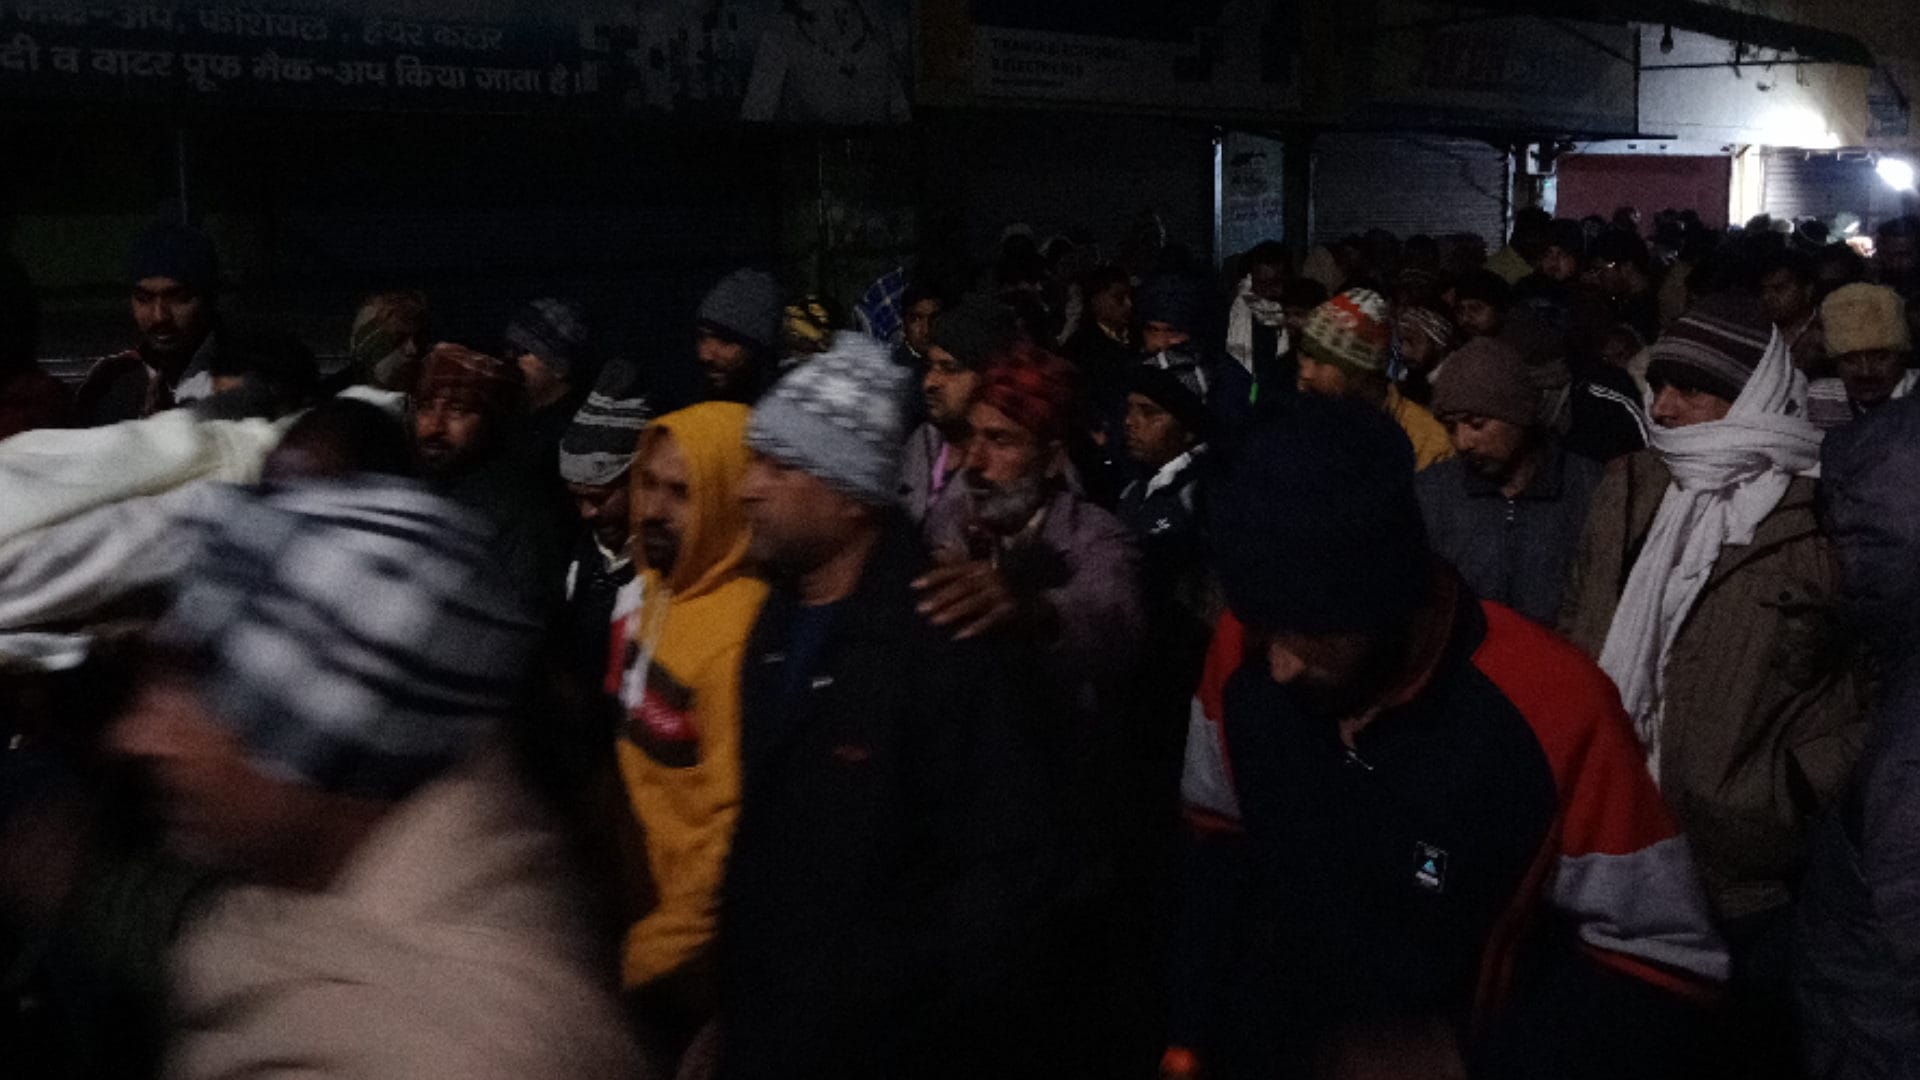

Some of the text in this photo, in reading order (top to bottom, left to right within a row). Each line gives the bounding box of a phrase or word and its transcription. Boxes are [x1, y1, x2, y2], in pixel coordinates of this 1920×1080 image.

[90, 47, 174, 76] वाटर
[394, 54, 466, 88] किया
[473, 66, 541, 93] जाता
